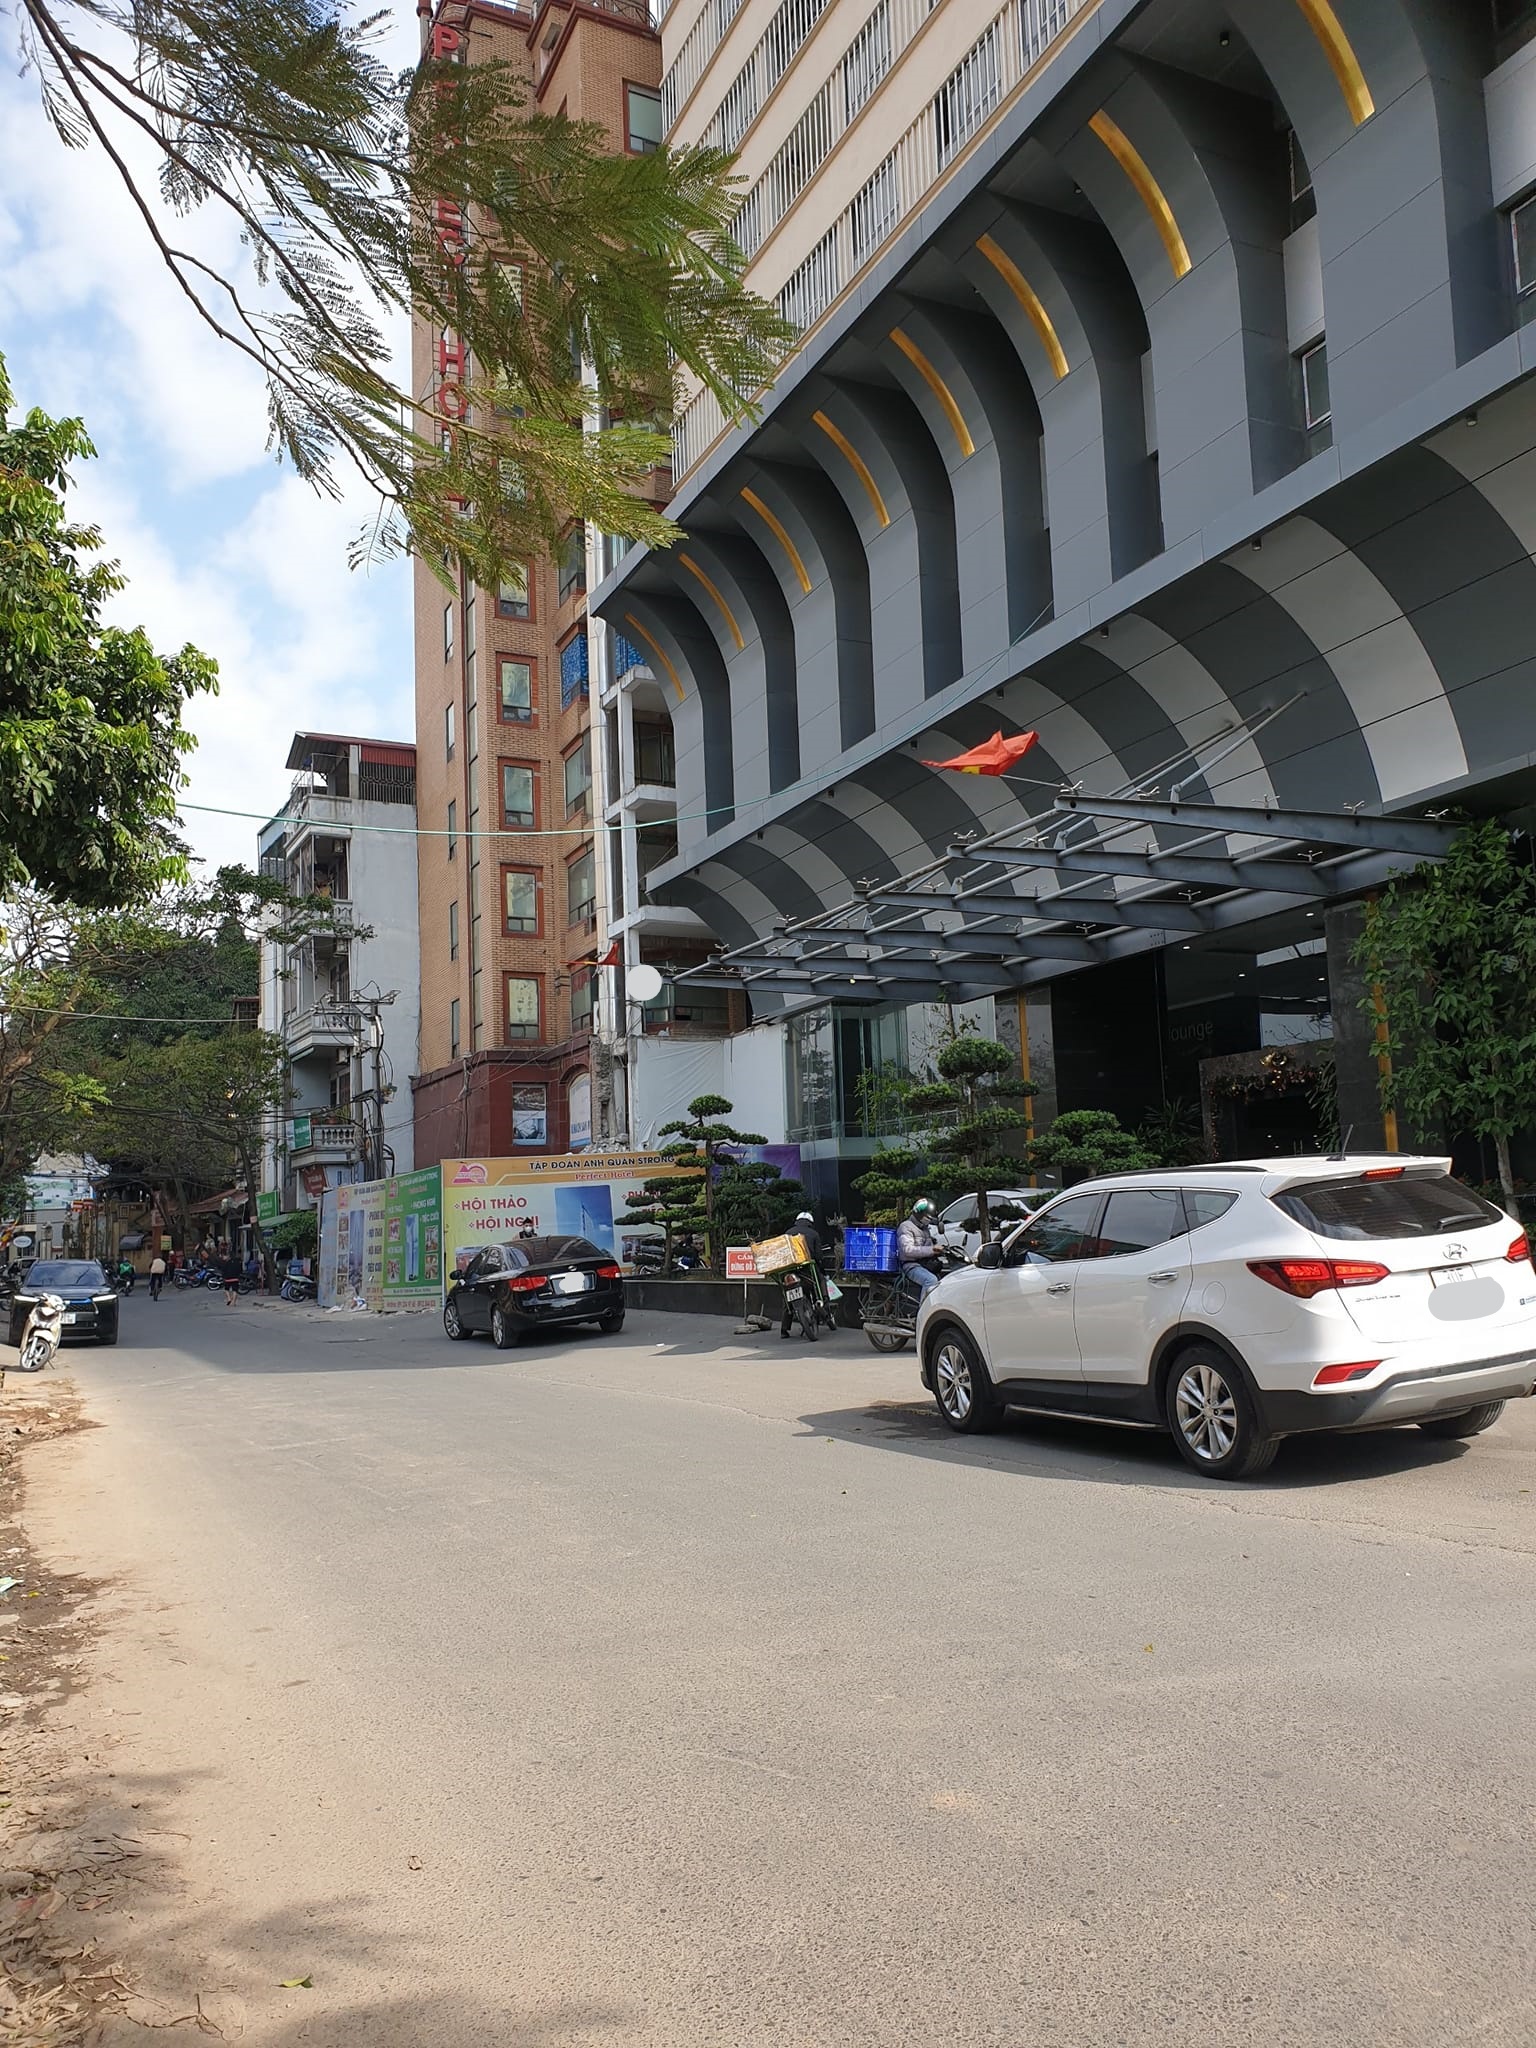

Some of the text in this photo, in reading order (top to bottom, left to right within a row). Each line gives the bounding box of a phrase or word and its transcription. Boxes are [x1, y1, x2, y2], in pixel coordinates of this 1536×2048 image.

[551, 1158, 580, 1169] ĐOÀN
[583, 1158, 604, 1168] ANH
[637, 1154, 675, 1165] STRONG
[575, 1171, 634, 1180] Perfect Hotel
[461, 1194, 527, 1213] HỘI THẢO
[476, 1216, 501, 1232] HỘI
